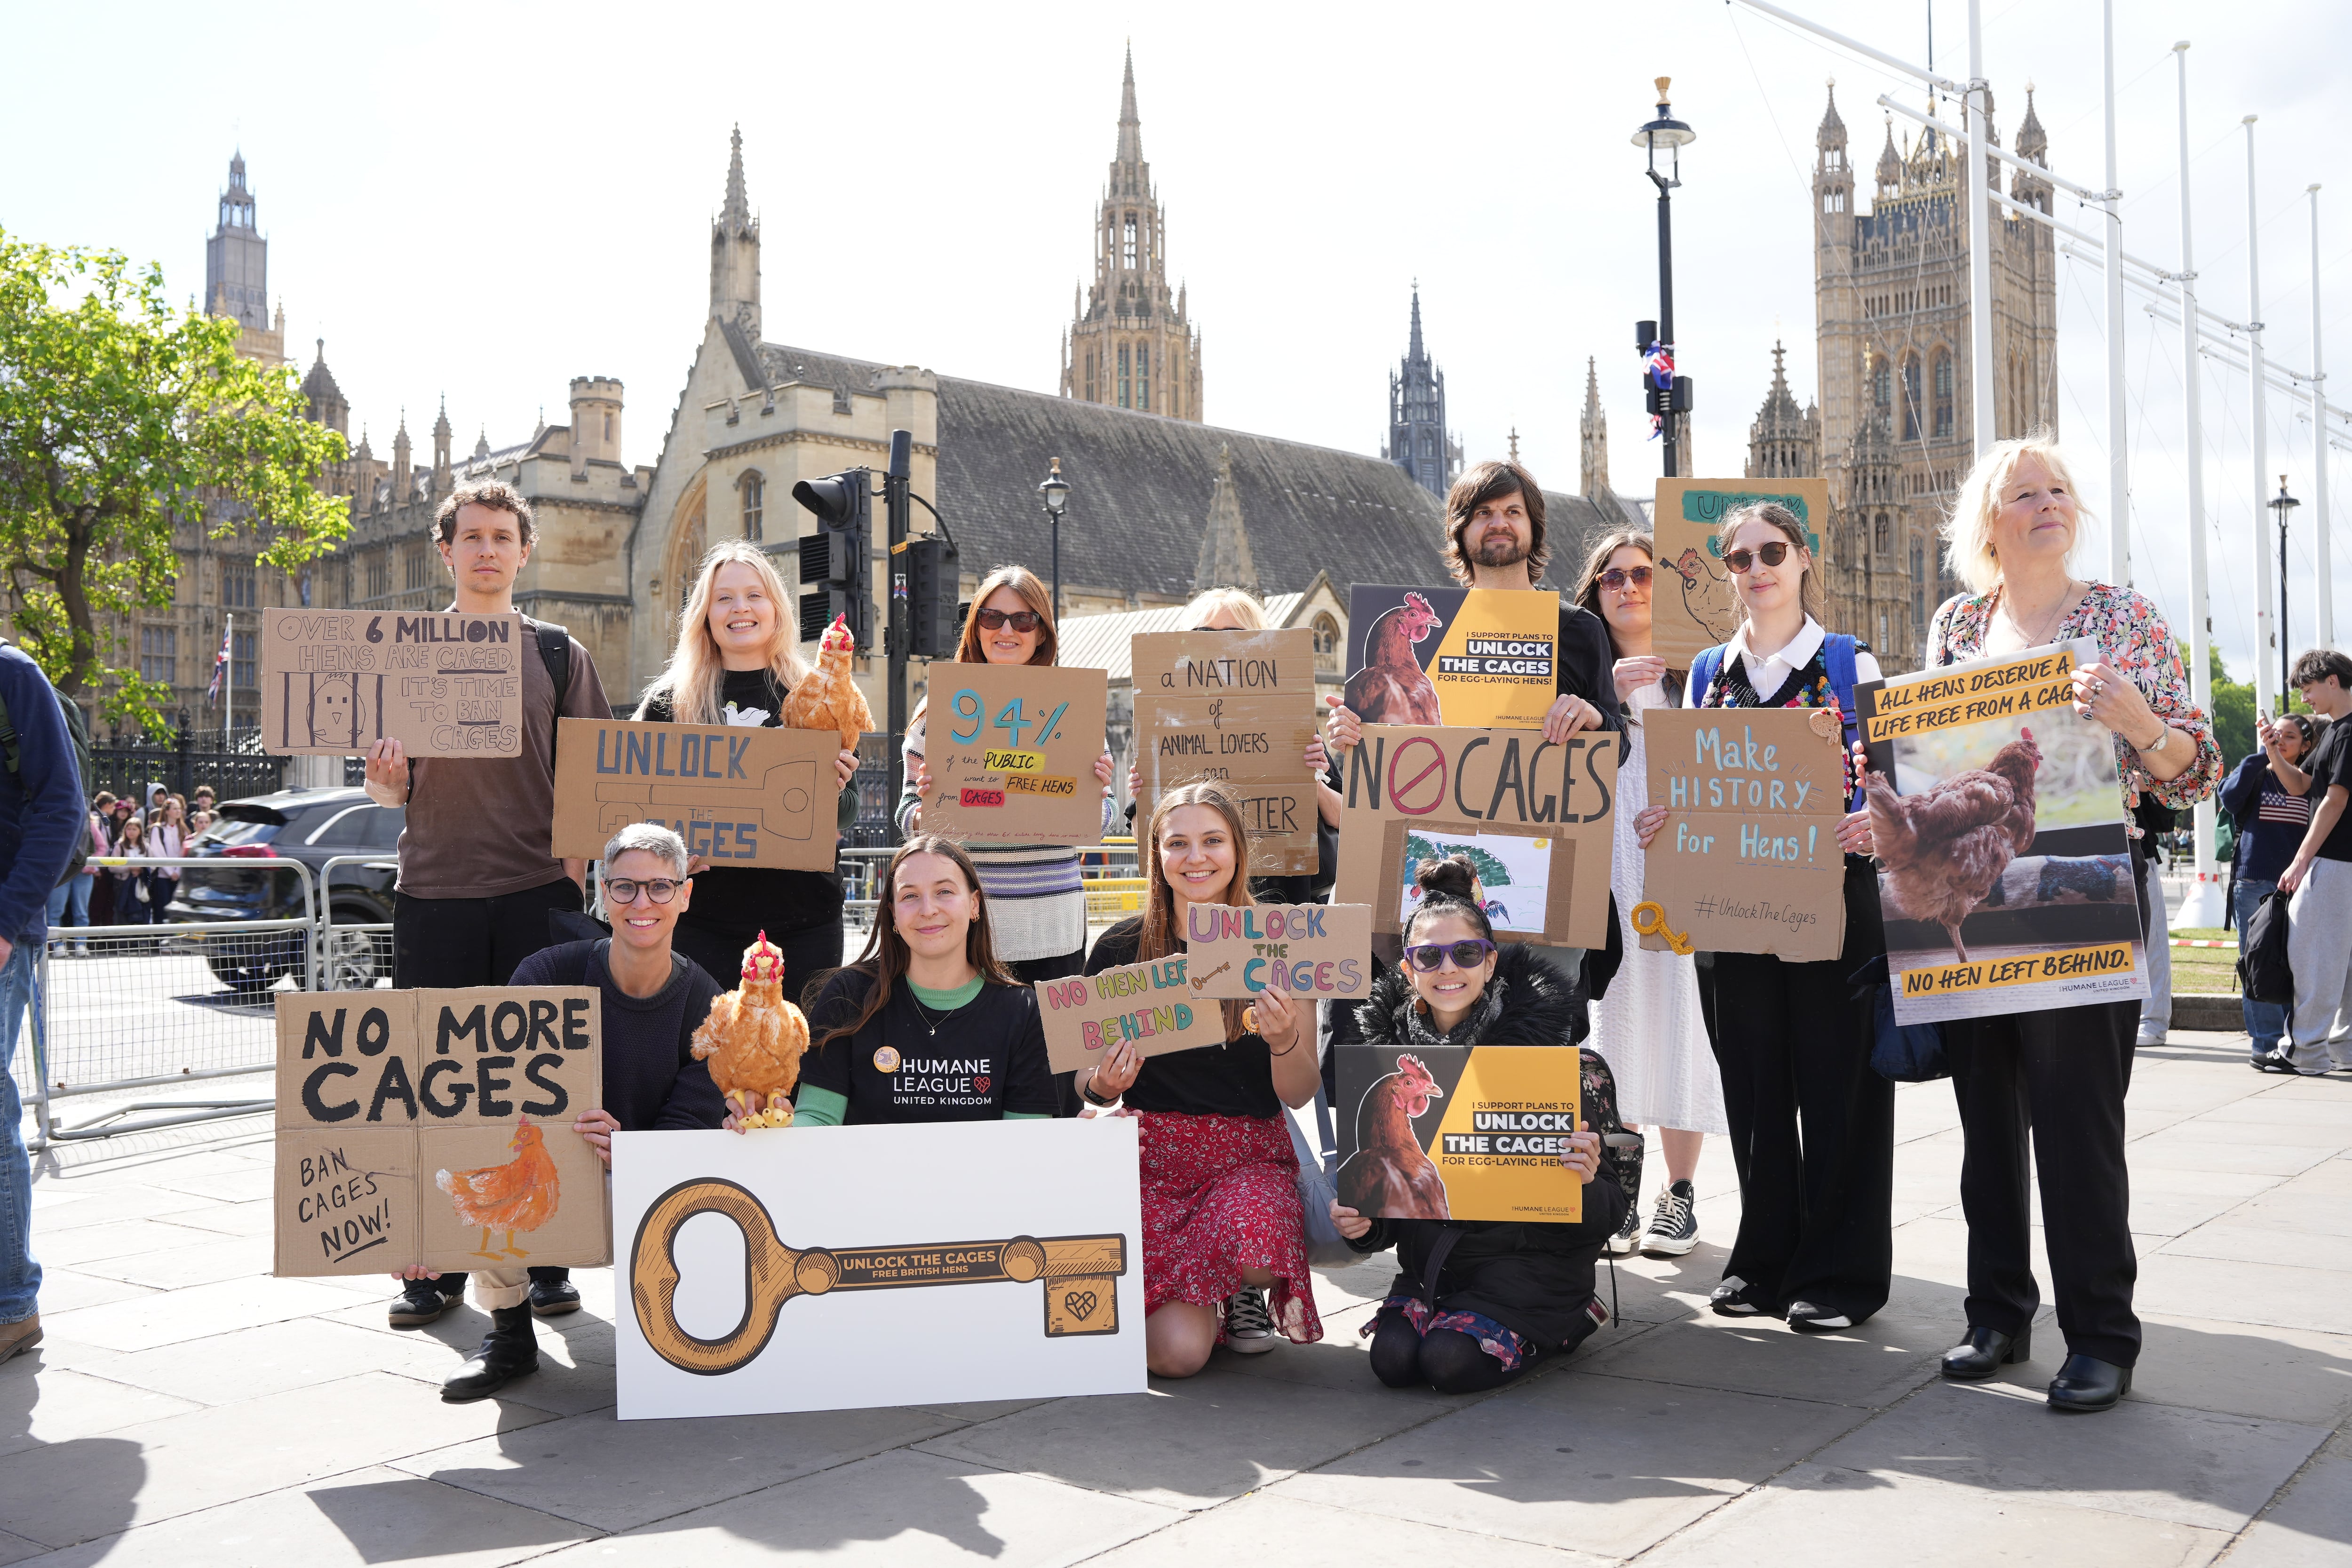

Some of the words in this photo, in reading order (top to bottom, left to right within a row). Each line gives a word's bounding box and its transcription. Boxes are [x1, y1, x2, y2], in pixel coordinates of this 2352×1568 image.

[278, 615, 355, 641] OVER
[366, 616, 383, 644] 6
[396, 616, 509, 644] MILLION
[299, 645, 376, 671] HENS
[385, 645, 429, 669] ARE
[437, 646, 516, 670] CAGED.
[1469, 641, 1550, 656] UNLOCK
[1161, 672, 1175, 688] a
[1187, 659, 1278, 689] NATION
[1441, 658, 1480, 672] THE
[1485, 659, 1550, 675] CAGES
[1460, 675, 1520, 684] EGG-LAYING
[401, 677, 448, 698] IT'S
[454, 677, 518, 697] TIME
[1881, 690, 1913, 710] ALL
[1916, 678, 1965, 703] HENS
[1970, 659, 2052, 692] DESERVE
[2056, 655, 2069, 675] A
[410, 701, 448, 722] TO
[456, 700, 501, 721] BAN
[951, 688, 1069, 747] 94%
[1209, 699, 1223, 729] of
[1873, 716, 1911, 738] LIFE
[1916, 705, 1961, 729] FREE
[1966, 695, 2014, 718] FROM
[2018, 693, 2032, 710] A
[2037, 682, 2079, 705] CAG
[431, 725, 517, 752] CAGES
[1160, 733, 1213, 756] ANIMAL
[1221, 732, 1269, 754] LOVERS
[1695, 725, 1780, 772] Make
[596, 729, 751, 780] UNLOCK
[946, 755, 955, 772] of
[961, 756, 978, 764] the
[984, 752, 1034, 769] PUBLIC
[1007, 776, 1039, 791] FREE
[1041, 780, 1073, 794] HENS
[1454, 736, 1611, 823] CAGES
[1670, 776, 1811, 810] HISTORY
[936, 793, 959, 808] from
[964, 790, 1002, 804] CAGES
[1233, 796, 1298, 831] TTER
[688, 808, 714, 820] THE
[1677, 821, 1716, 853] for
[1189, 907, 1327, 943] UNLOCK
[1694, 894, 1816, 932] #UnlockTheCages
[1253, 943, 1289, 959] THE
[1047, 980, 1088, 1011] NO
[1096, 969, 1148, 1000] HEN
[1152, 959, 1187, 989] LEF
[1244, 957, 1362, 993] CAGES
[1907, 973, 1934, 993] NO
[1938, 966, 1982, 988] HEN
[1988, 959, 2040, 984] LEFT
[2042, 949, 2130, 977] BEHIND.
[2062, 982, 2097, 992] HUMANE
[2098, 979, 2129, 987] LEAGUE
[302, 1007, 389, 1059] NO
[436, 998, 591, 1054] MORE
[1082, 1003, 1193, 1050] BEHIND
[903, 1059, 991, 1074] HUMANE
[301, 1053, 569, 1122] CAGES
[894, 1077, 971, 1093] LEAGUE
[1475, 1114, 1571, 1130] UNLOCK
[1445, 1136, 1489, 1152] THE
[1495, 1137, 1572, 1154] CAGES
[300, 1147, 349, 1187] BAN
[1469, 1157, 1538, 1166] EGG-LAYING
[298, 1170, 378, 1223] CAGES
[320, 1198, 390, 1258] NOW!
[843, 1255, 908, 1271] UNLOCK
[911, 1253, 943, 1266] THE
[945, 1250, 996, 1264] CAGES
[872, 1269, 898, 1278] FREE
[900, 1267, 940, 1276] BRITISH
[943, 1265, 969, 1274] HENS
